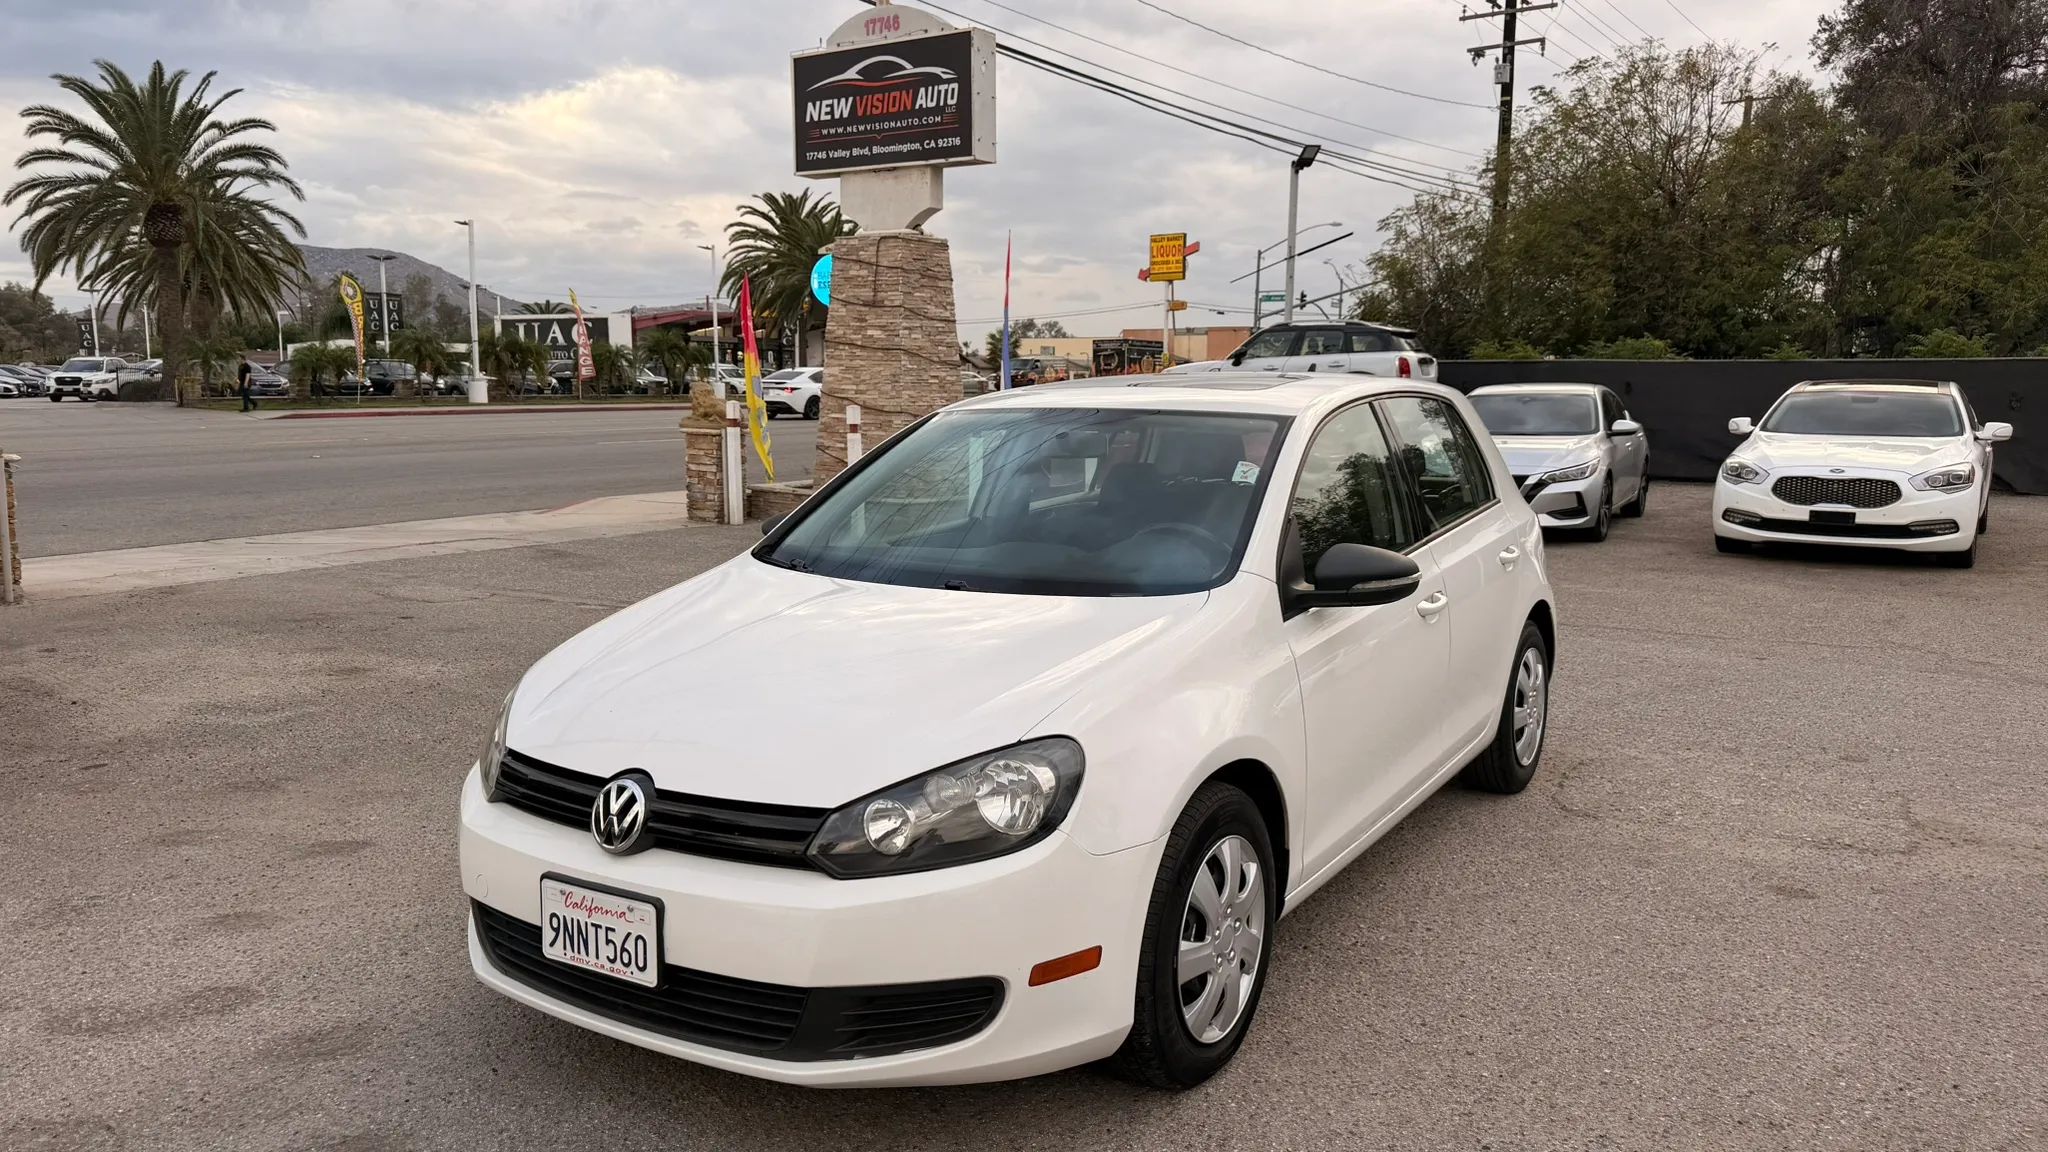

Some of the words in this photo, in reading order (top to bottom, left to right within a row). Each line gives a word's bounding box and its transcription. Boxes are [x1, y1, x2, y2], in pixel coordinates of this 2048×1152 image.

[864, 14, 900, 36] 17746
[805, 97, 853, 122] NEW
[856, 89, 913, 116] VISION
[915, 83, 959, 109] AUTO
[821, 116, 941, 135] WWW.NEWVISIONAUTO.COM
[806, 150, 827, 160] 17746
[828, 149, 850, 158] Valley
[852, 146, 871, 156] Blvd,
[872, 143, 922, 155] Bloomington,
[924, 140, 936, 148] CA
[937, 137, 961, 147] 92316
[1152, 244, 1184, 258] LIQUOR
[369, 299, 380, 330] UAC
[389, 301, 400, 331] UAC
[81, 324, 92, 347] UAC
[564, 891, 634, 923] California
[549, 912, 648, 972] 9NNT560
[569, 954, 628, 976] dmv.ca.gov
